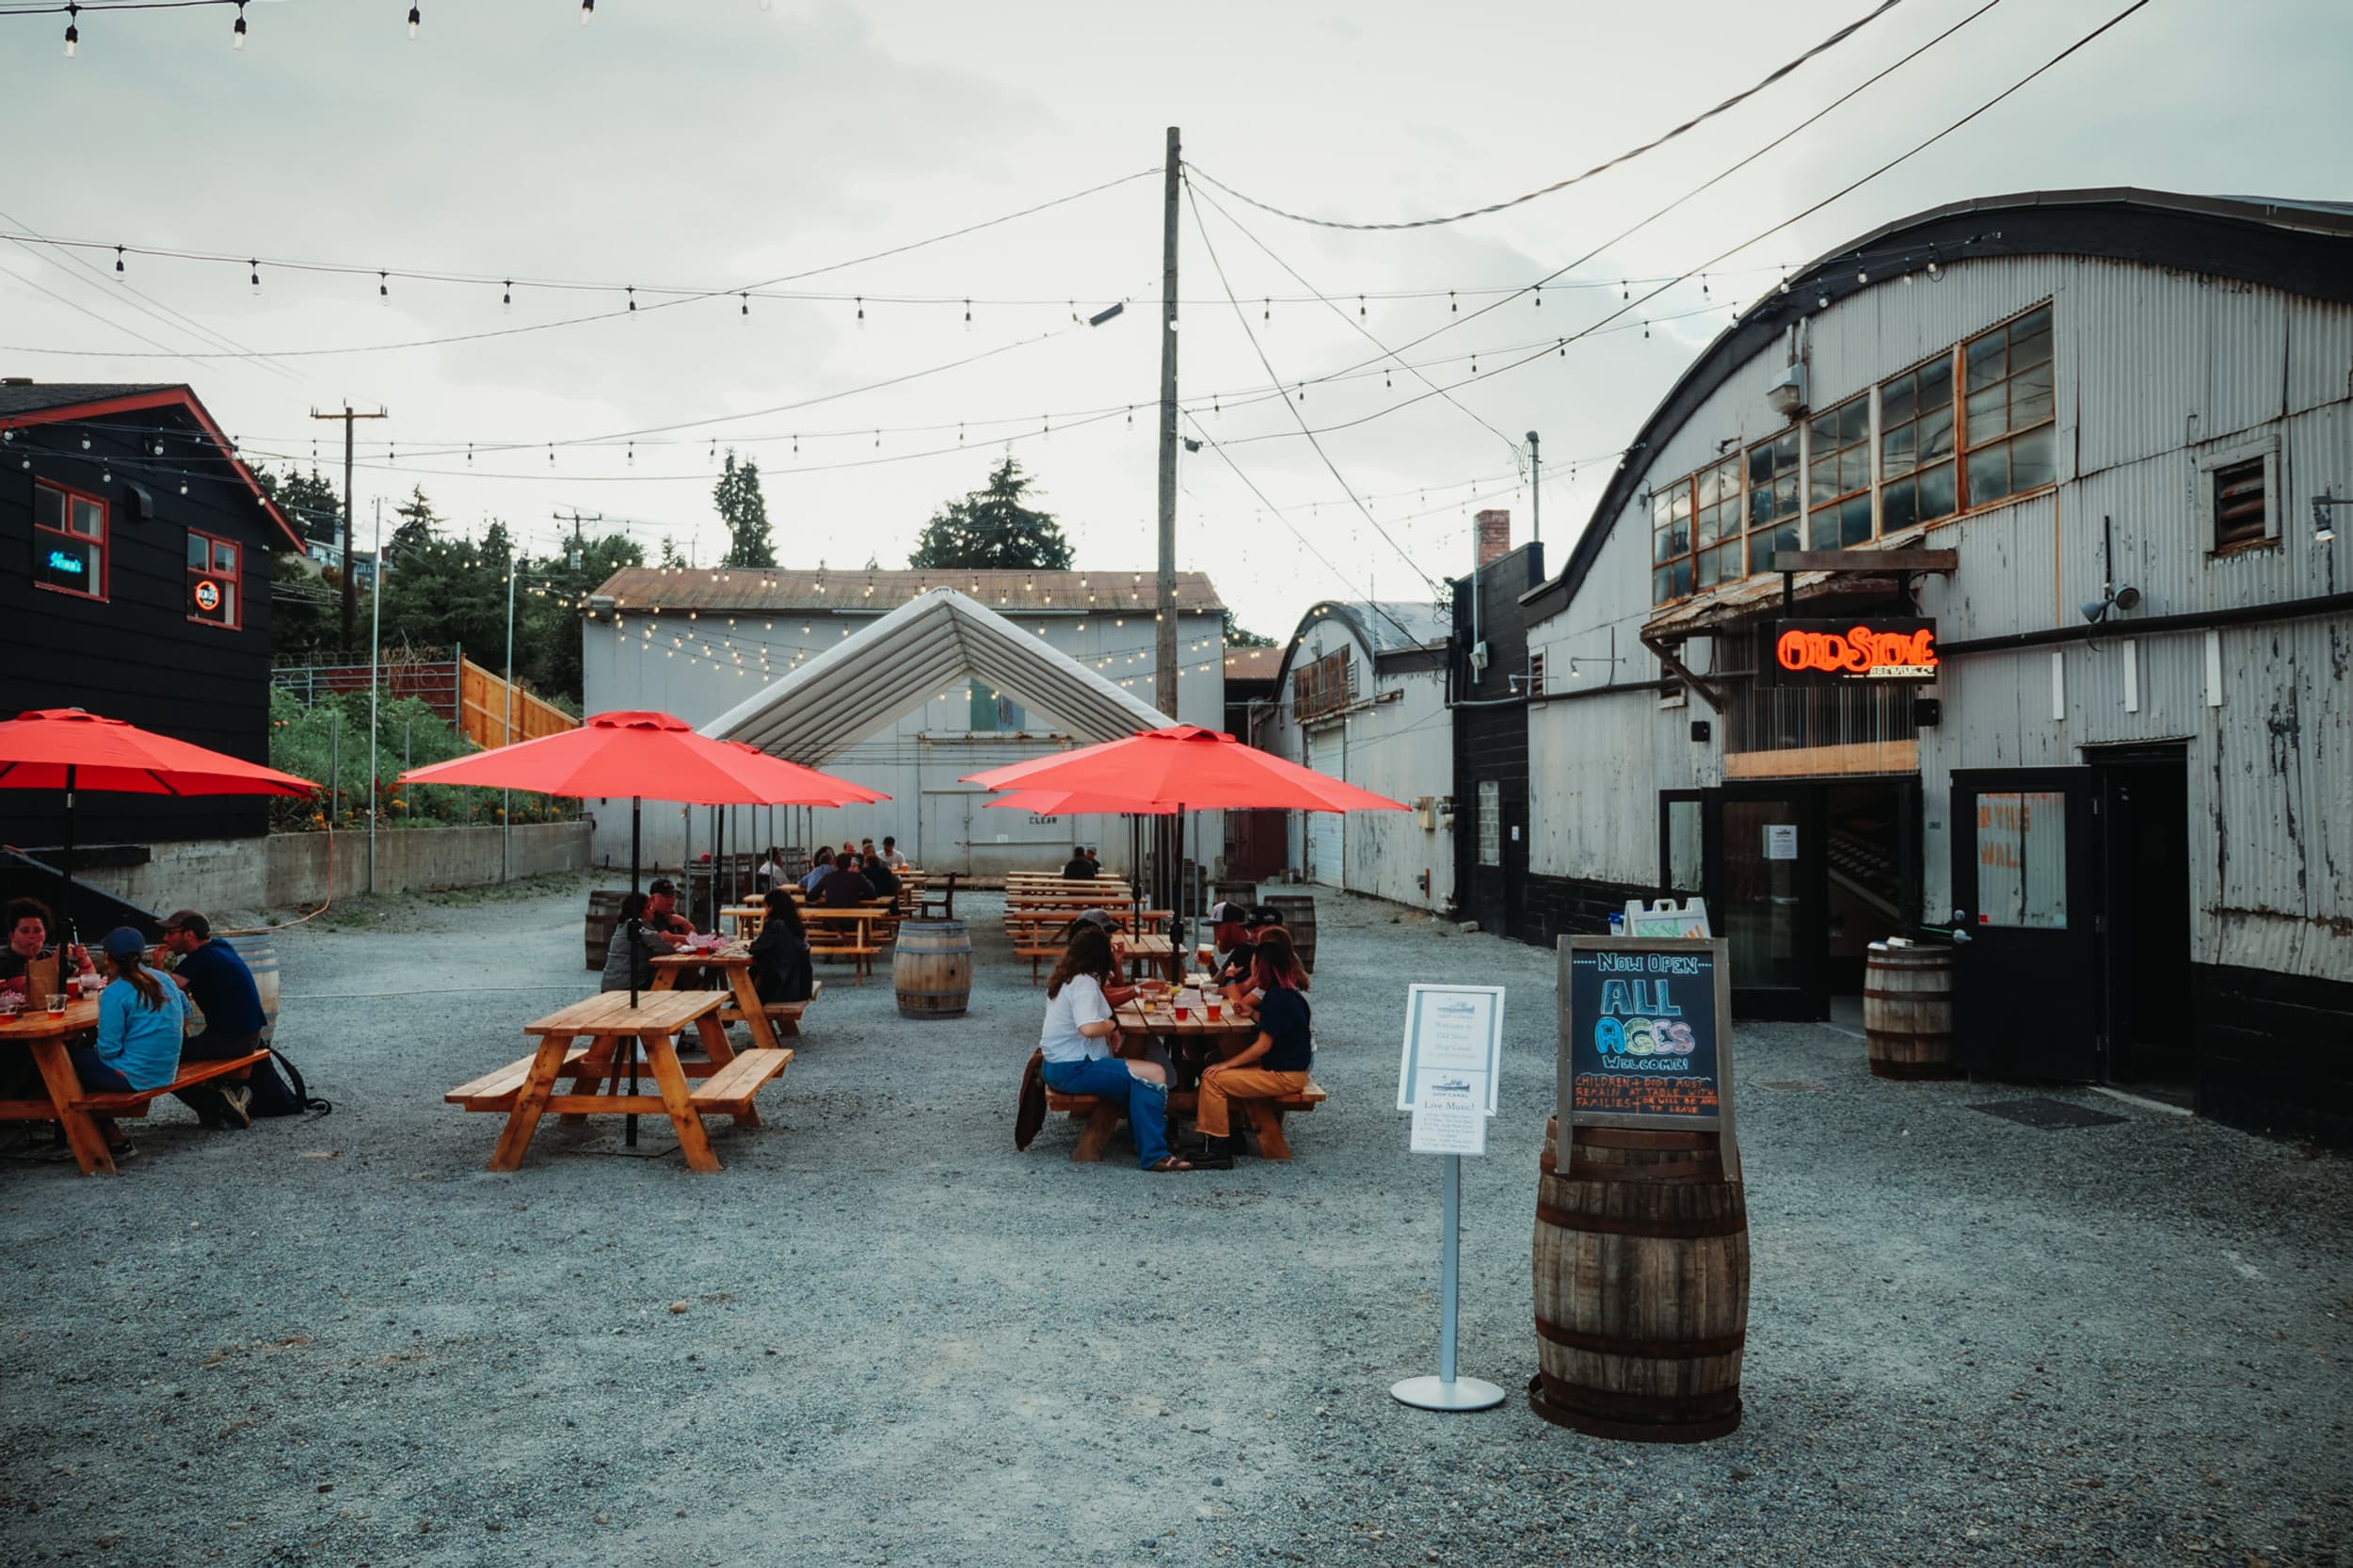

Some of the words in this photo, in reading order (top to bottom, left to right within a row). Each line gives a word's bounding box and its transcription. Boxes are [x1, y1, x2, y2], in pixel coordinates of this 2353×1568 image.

[1597, 952, 1643, 971] NOW
[1648, 953, 1699, 974] OPEN
[1600, 979, 1682, 1016] ALL
[1595, 1016, 1695, 1055] AGES
[1602, 1055, 1688, 1070] WELCOME!
[1576, 1076, 1629, 1087] CHILDREN
[1576, 1087, 1621, 1097] REMAIN
[1629, 1086, 1641, 1096] AT
[1646, 1087, 1680, 1097] TABLE
[1424, 1099, 1443, 1109] Live
[1446, 1101, 1475, 1111] Music!
[1576, 1096, 1631, 1109] FAMILIES
[1642, 1096, 1655, 1105] OR
[1669, 1106, 1699, 1114] LEAVE
